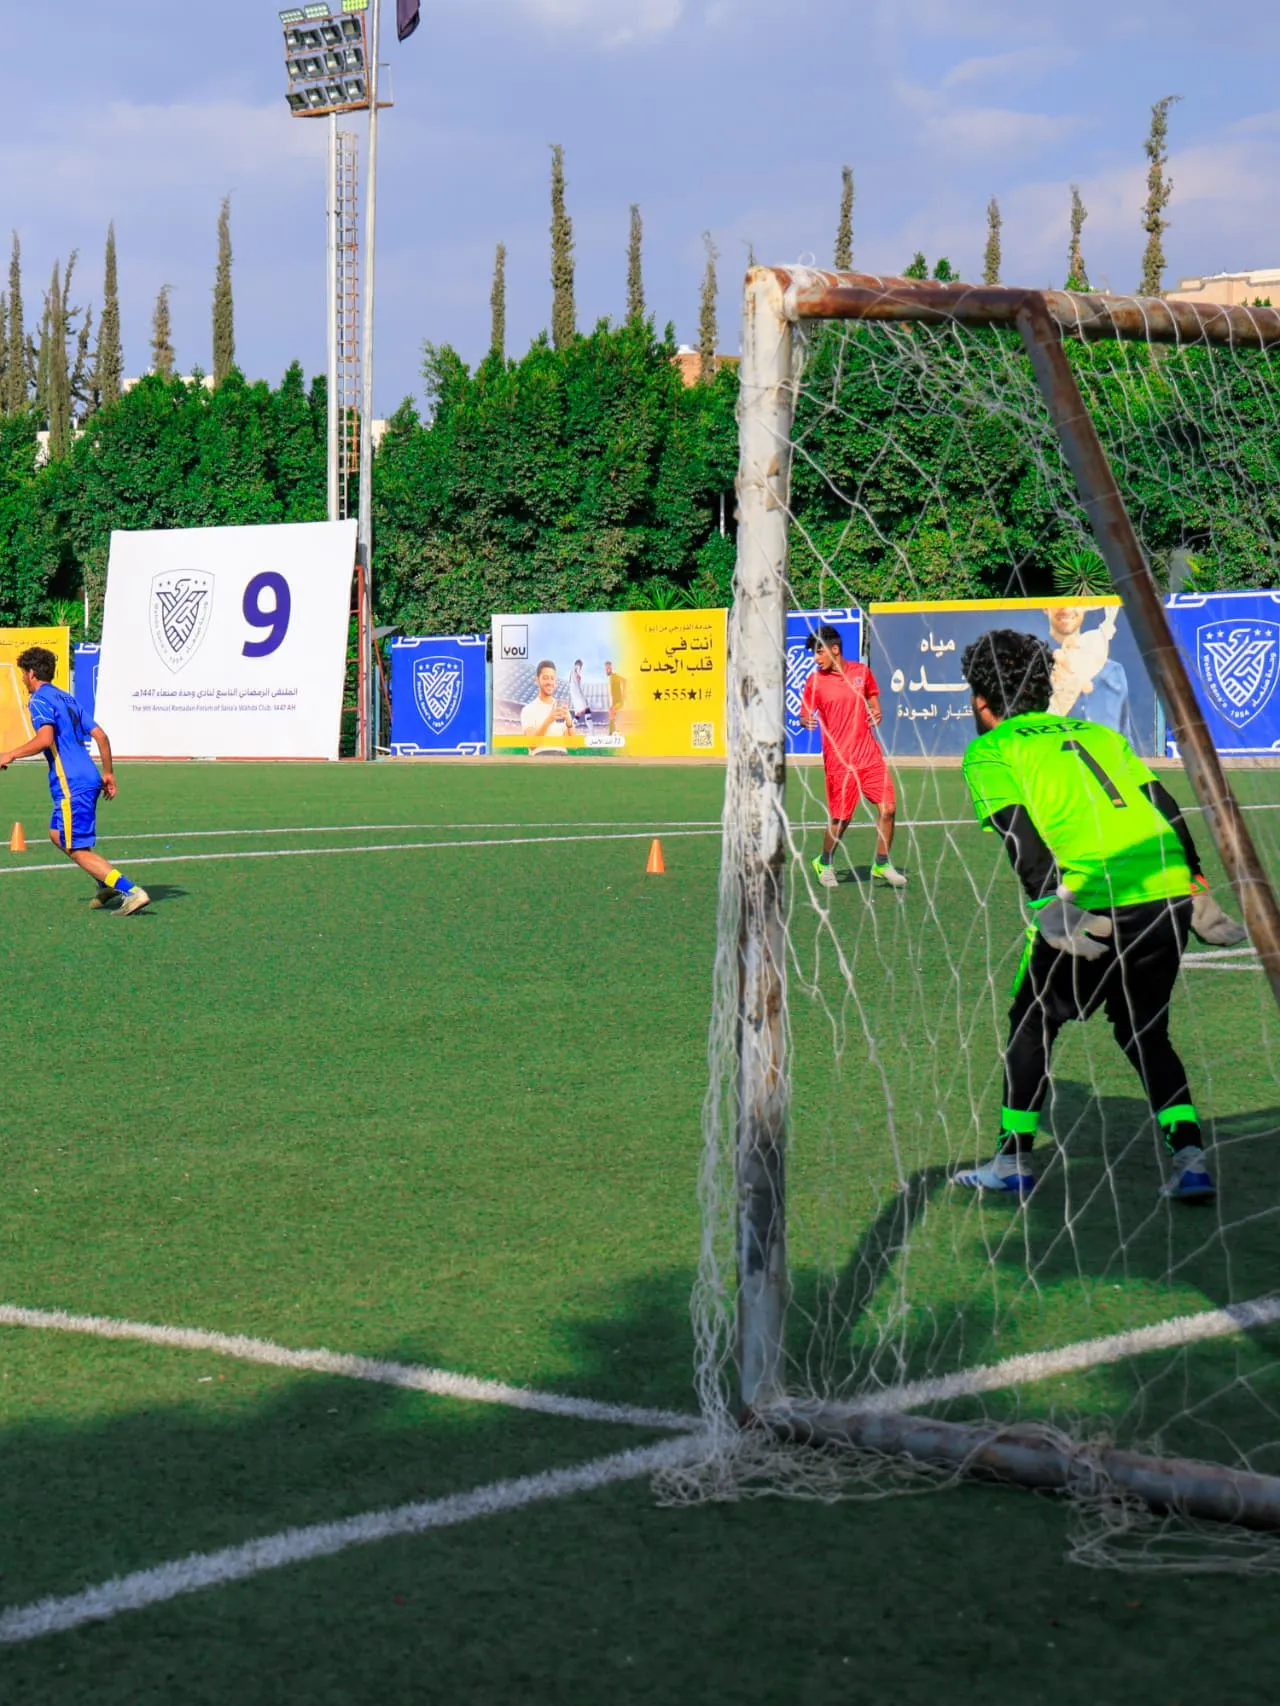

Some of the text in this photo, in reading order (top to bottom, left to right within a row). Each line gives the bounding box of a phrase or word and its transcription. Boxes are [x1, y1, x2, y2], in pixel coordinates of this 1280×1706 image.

[242, 571, 291, 658] 9
[503, 646, 526, 656] YOU
[665, 633, 713, 658] أنت في
[920, 631, 956, 658] مياه
[639, 656, 713, 677] قلب الحدث
[1203, 654, 1213, 682] Wahda
[156, 687, 177, 697] صنعاء
[178, 687, 196, 698] وحدة
[196, 687, 215, 698] لنادي
[216, 687, 238, 699] التاسع
[152, 703, 171, 712] Annual
[172, 703, 195, 712] Ramadan
[196, 703, 213, 712] Forum
[897, 703, 938, 720] الجودة
[1016, 721, 1091, 737] AZIZ
[1061, 740, 1128, 809] 1
